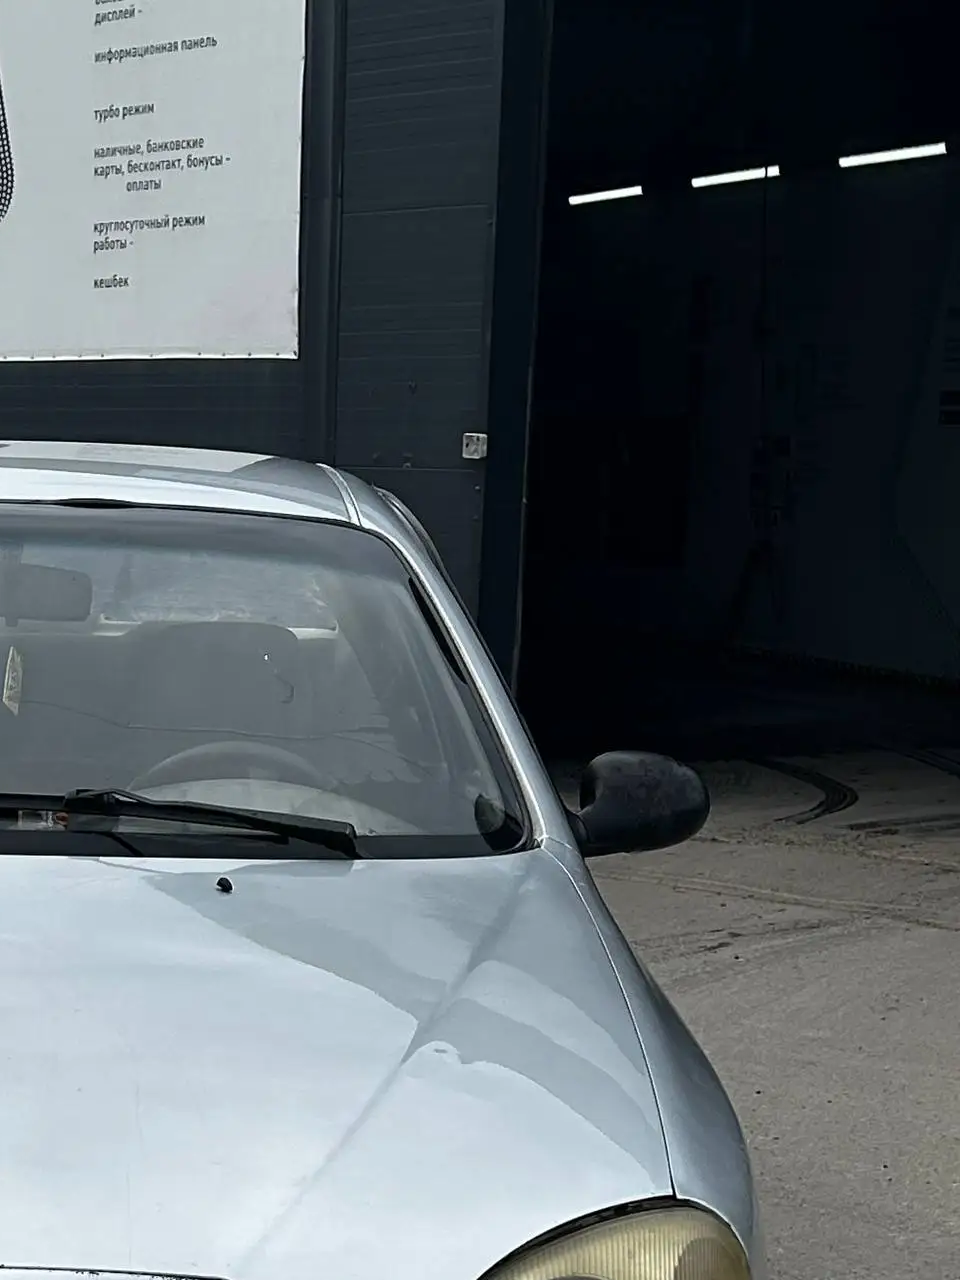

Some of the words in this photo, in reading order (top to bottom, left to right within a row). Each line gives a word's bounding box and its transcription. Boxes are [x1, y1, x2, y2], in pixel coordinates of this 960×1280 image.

[94, 4, 136, 27] дисплей
[94, 39, 178, 64] информационная
[181, 35, 217, 52] панель
[94, 104, 120, 123] турбо
[122, 102, 155, 120] режим
[94, 142, 144, 158] наличные,
[146, 136, 204, 153] банковские
[94, 161, 125, 178] карты,
[127, 156, 184, 175] бесконтакт,
[186, 153, 223, 172] бонусы
[126, 178, 161, 192] оплаты
[94, 214, 170, 235] круглосуточный
[172, 214, 205, 230] режим
[94, 237, 127, 253] работы
[93, 275, 129, 289] кешбек
